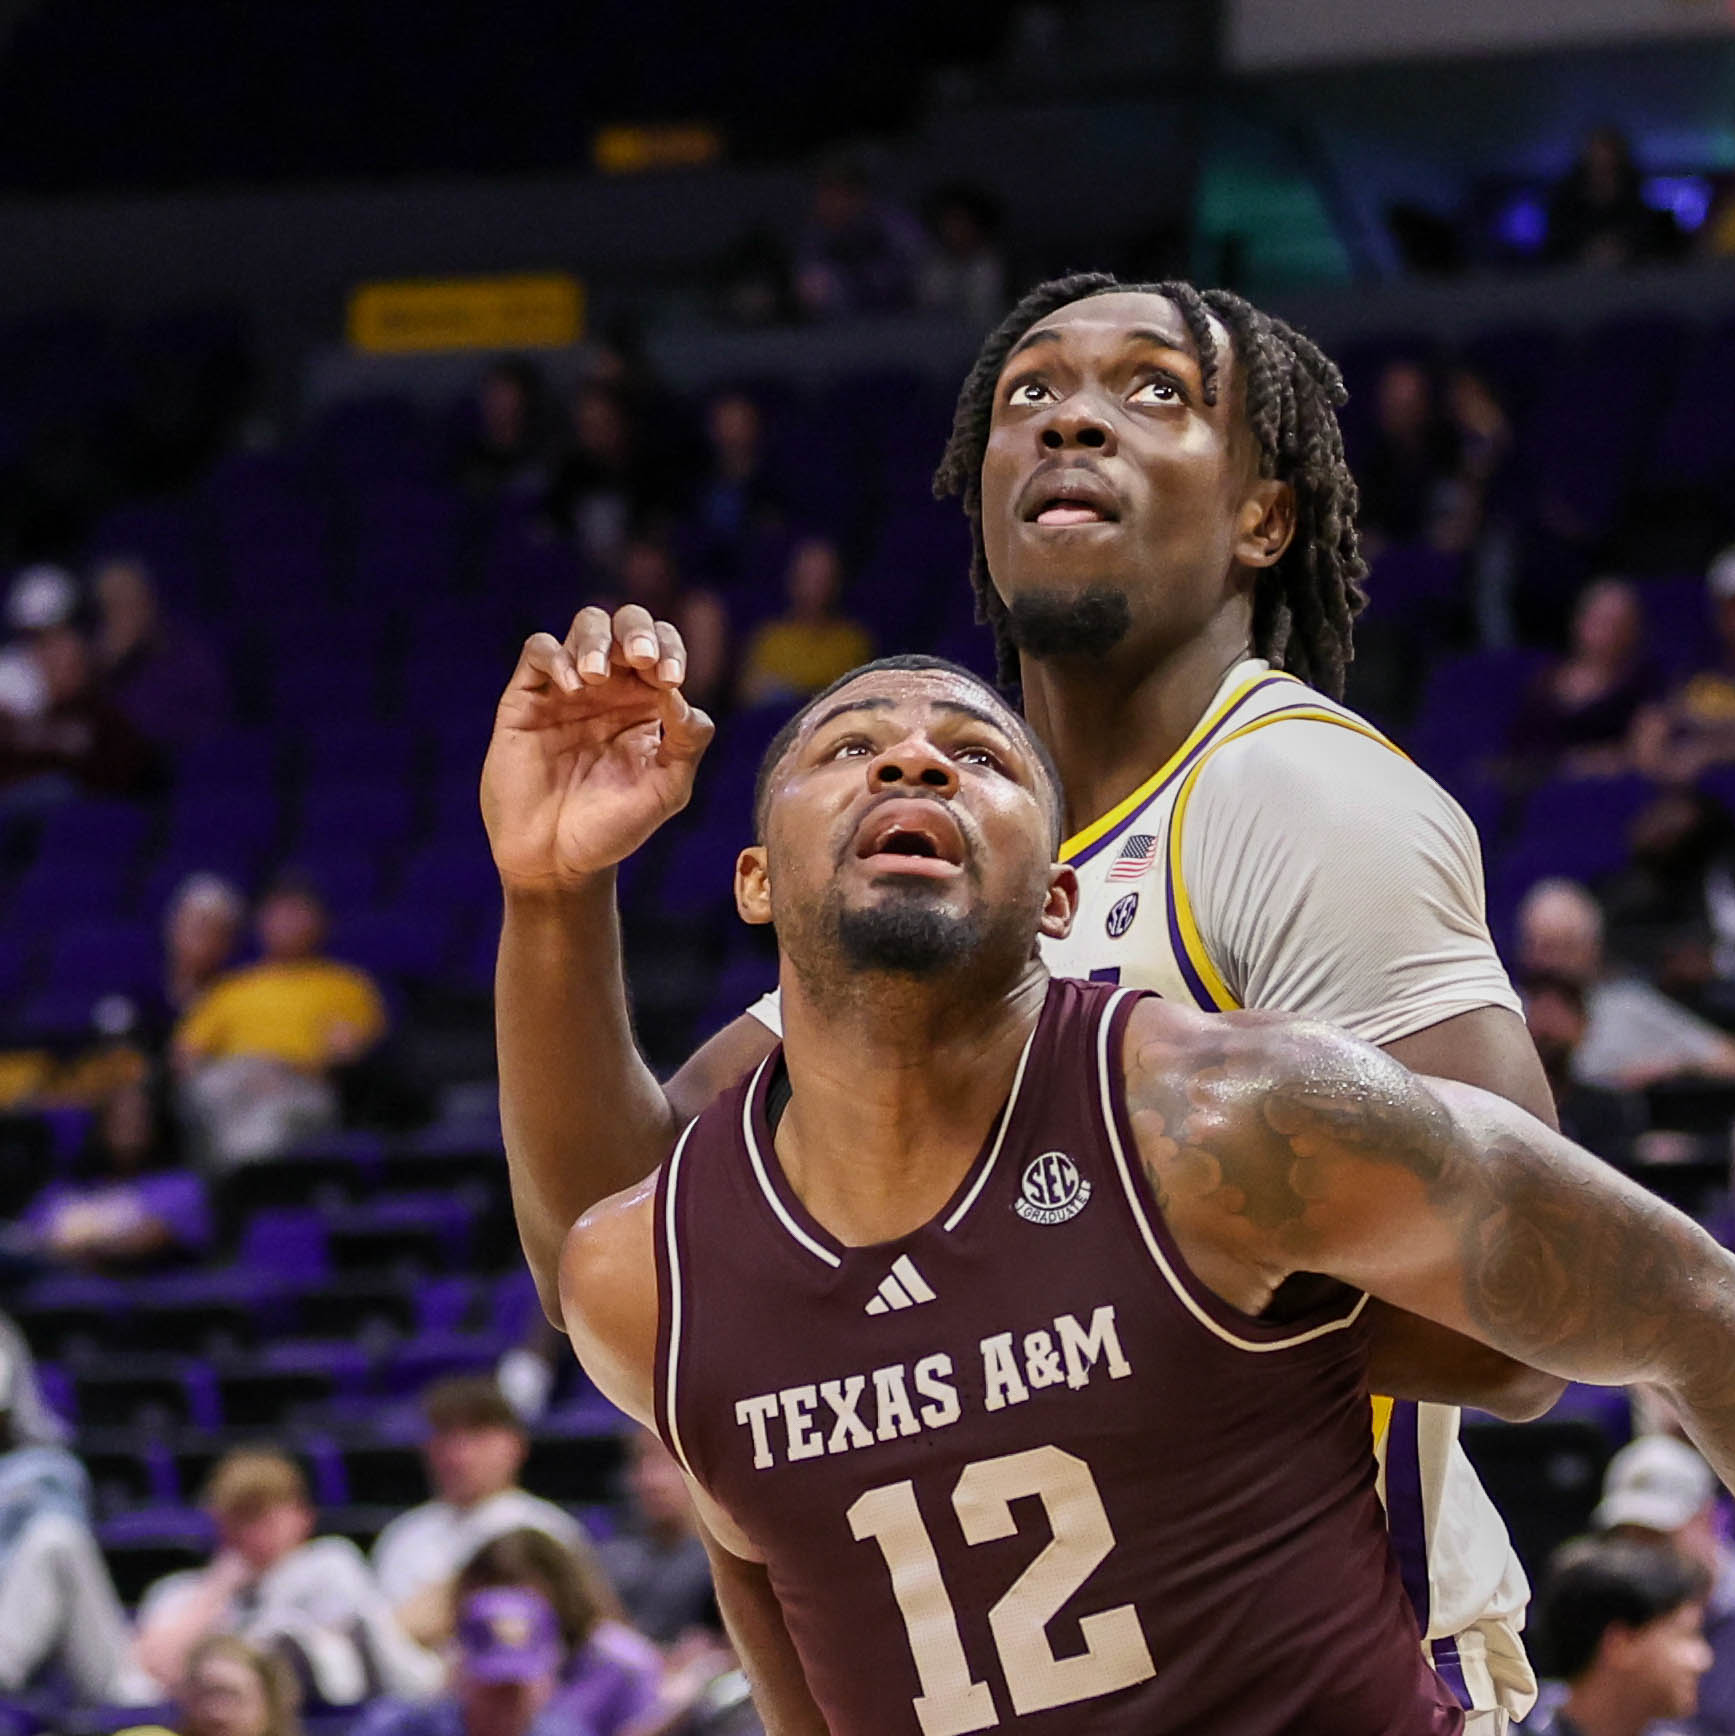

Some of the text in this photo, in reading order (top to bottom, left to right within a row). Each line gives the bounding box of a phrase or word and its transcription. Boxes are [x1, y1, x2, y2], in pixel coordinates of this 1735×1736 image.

[1106, 892, 1139, 937] SEC
[1025, 1154, 1077, 1206] SEC
[1021, 1190, 1089, 1223] GRADUATE
[735, 1305, 1132, 1470] TEXAS A&M
